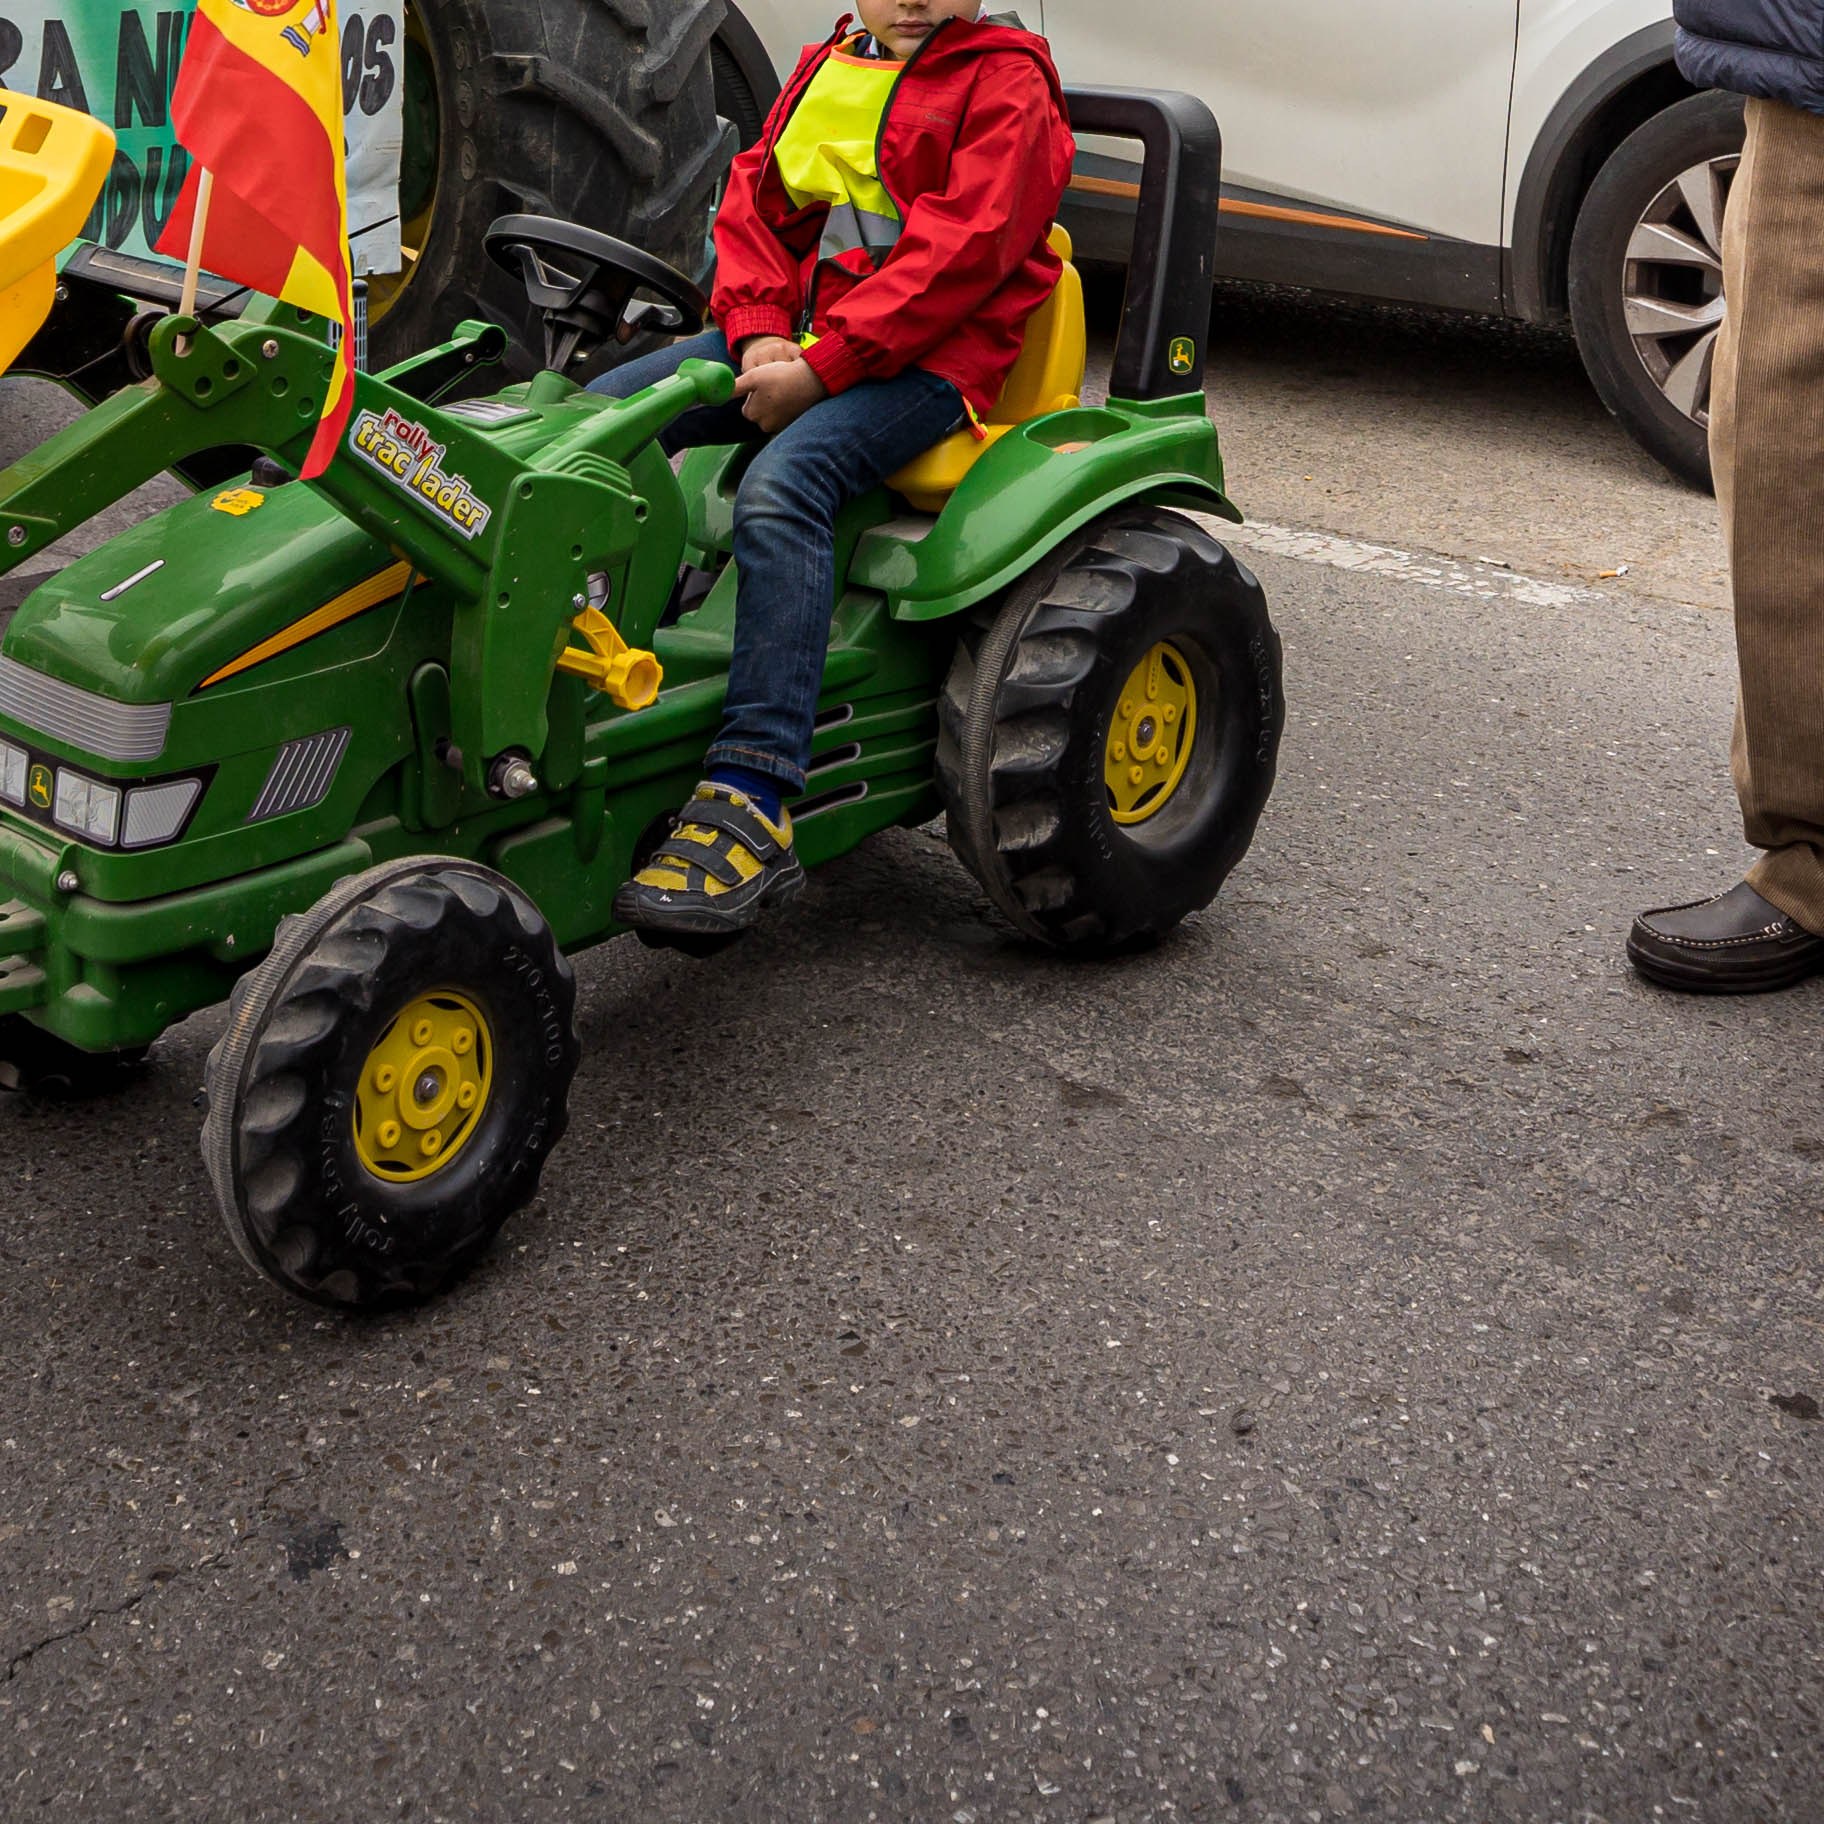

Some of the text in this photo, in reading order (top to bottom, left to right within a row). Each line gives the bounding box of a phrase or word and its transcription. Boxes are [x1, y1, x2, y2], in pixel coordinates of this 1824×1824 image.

[355, 420, 483, 528] trac lader
[383, 411, 436, 462] rolly
